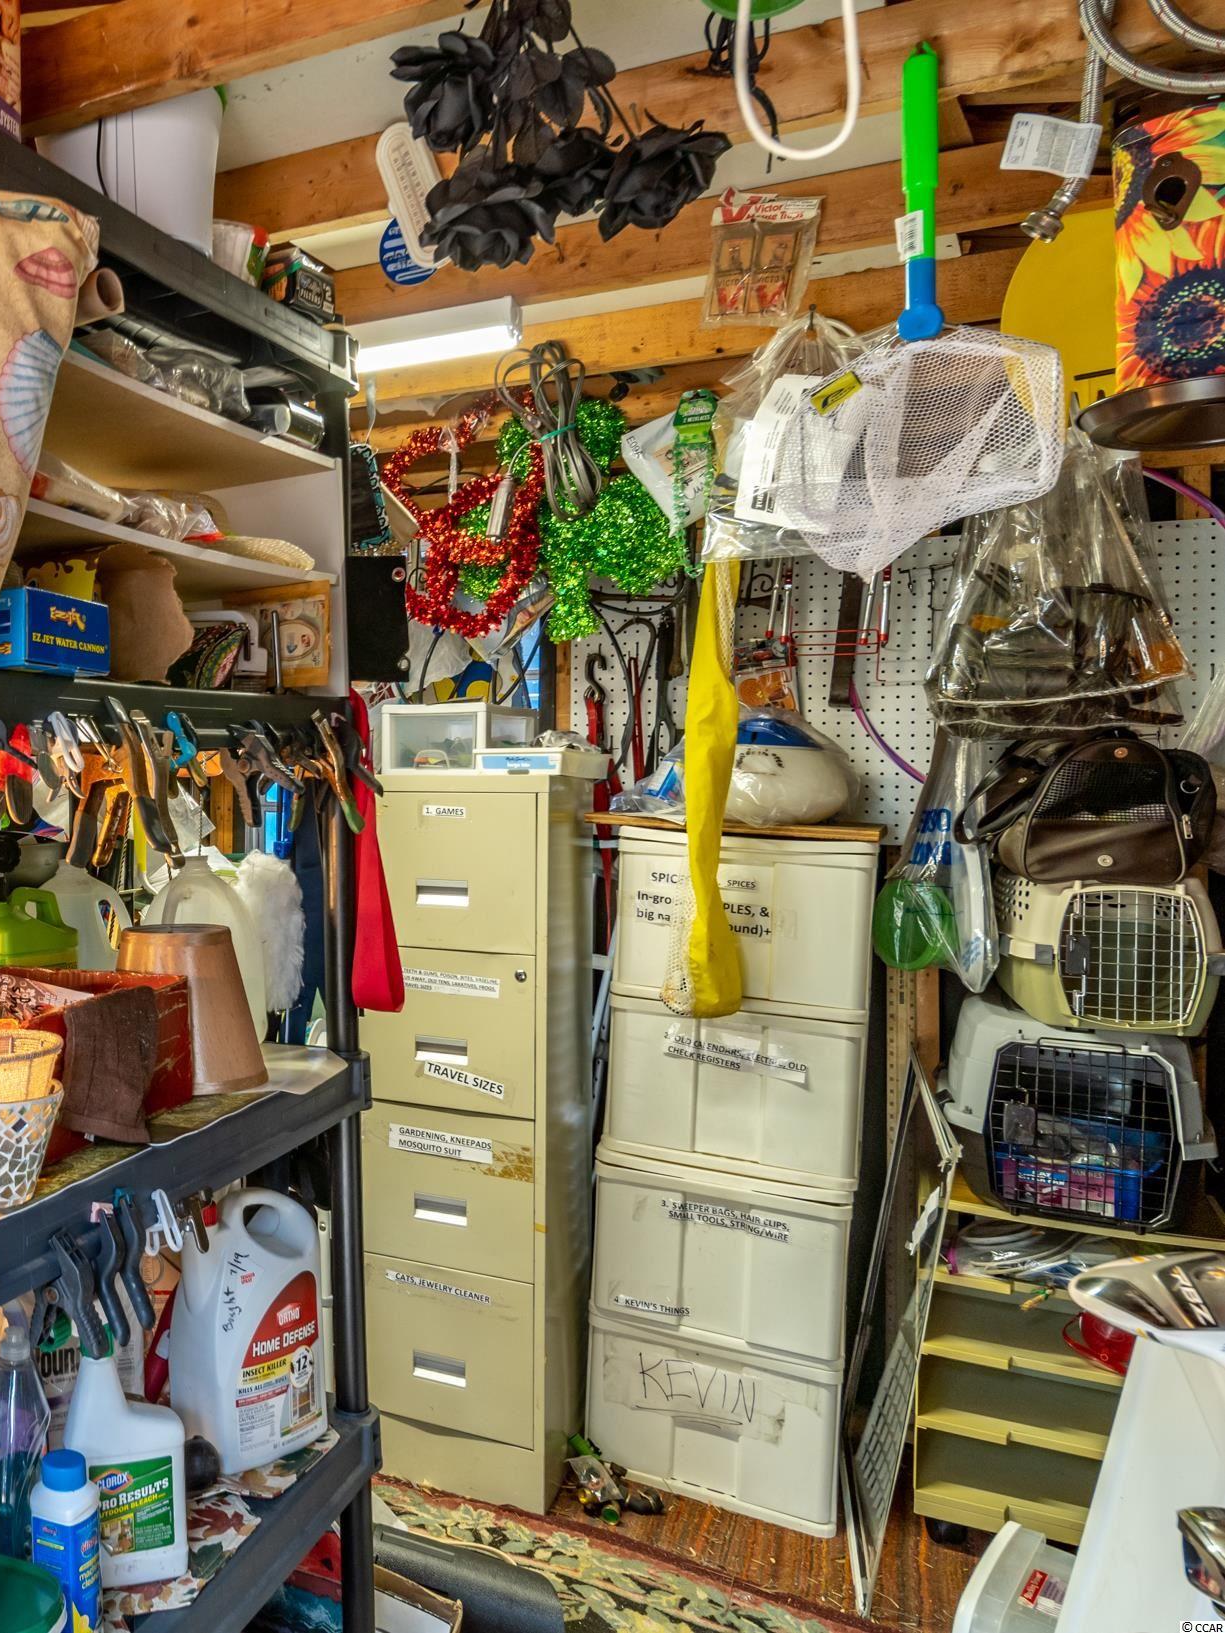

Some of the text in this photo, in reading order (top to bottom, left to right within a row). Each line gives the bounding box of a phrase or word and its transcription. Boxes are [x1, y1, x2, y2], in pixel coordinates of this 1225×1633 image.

[32, 632, 106, 654] EZ JET WATER CANNON
[425, 807, 465, 816] 1. GAMES
[727, 880, 756, 889] SPICES
[636, 908, 655, 921] big
[637, 890, 672, 905] In-gro
[759, 906, 770, 918] &
[668, 1045, 694, 1059] CHECK
[696, 1052, 741, 1070] REGISTERS
[788, 1061, 807, 1072] OLD
[427, 1062, 504, 1096] TRAVEL SIZES
[399, 1126, 492, 1150] GARDENING, KNEEPADS
[399, 1139, 462, 1157] MOSQUITO SUIT
[673, 1201, 710, 1213] SWEEPER
[712, 1207, 738, 1220] BAGS,
[740, 1212, 761, 1224] HAIR
[763, 1218, 790, 1232] CLIPS,
[697, 1213, 728, 1228] TOOLS,
[730, 1219, 789, 1242] STRING/WIRE
[395, 1272, 490, 1304] CATS, JEWELRY CLEANER
[278, 1307, 301, 1326] ORTHO
[624, 1298, 659, 1312] KEVIN'S
[659, 1305, 690, 1316] THINGS
[252, 1320, 316, 1358] HOME DEFENSE
[242, 1358, 287, 1379] INSECT KILLER
[295, 1355, 308, 1372] 12
[238, 1386, 253, 1395] KILLS
[638, 1352, 756, 1424] KEVIN
[97, 1472, 129, 1489] CLOROX
[119, 1477, 169, 1506] RESULTS
[130, 1493, 158, 1509] BLEACH
